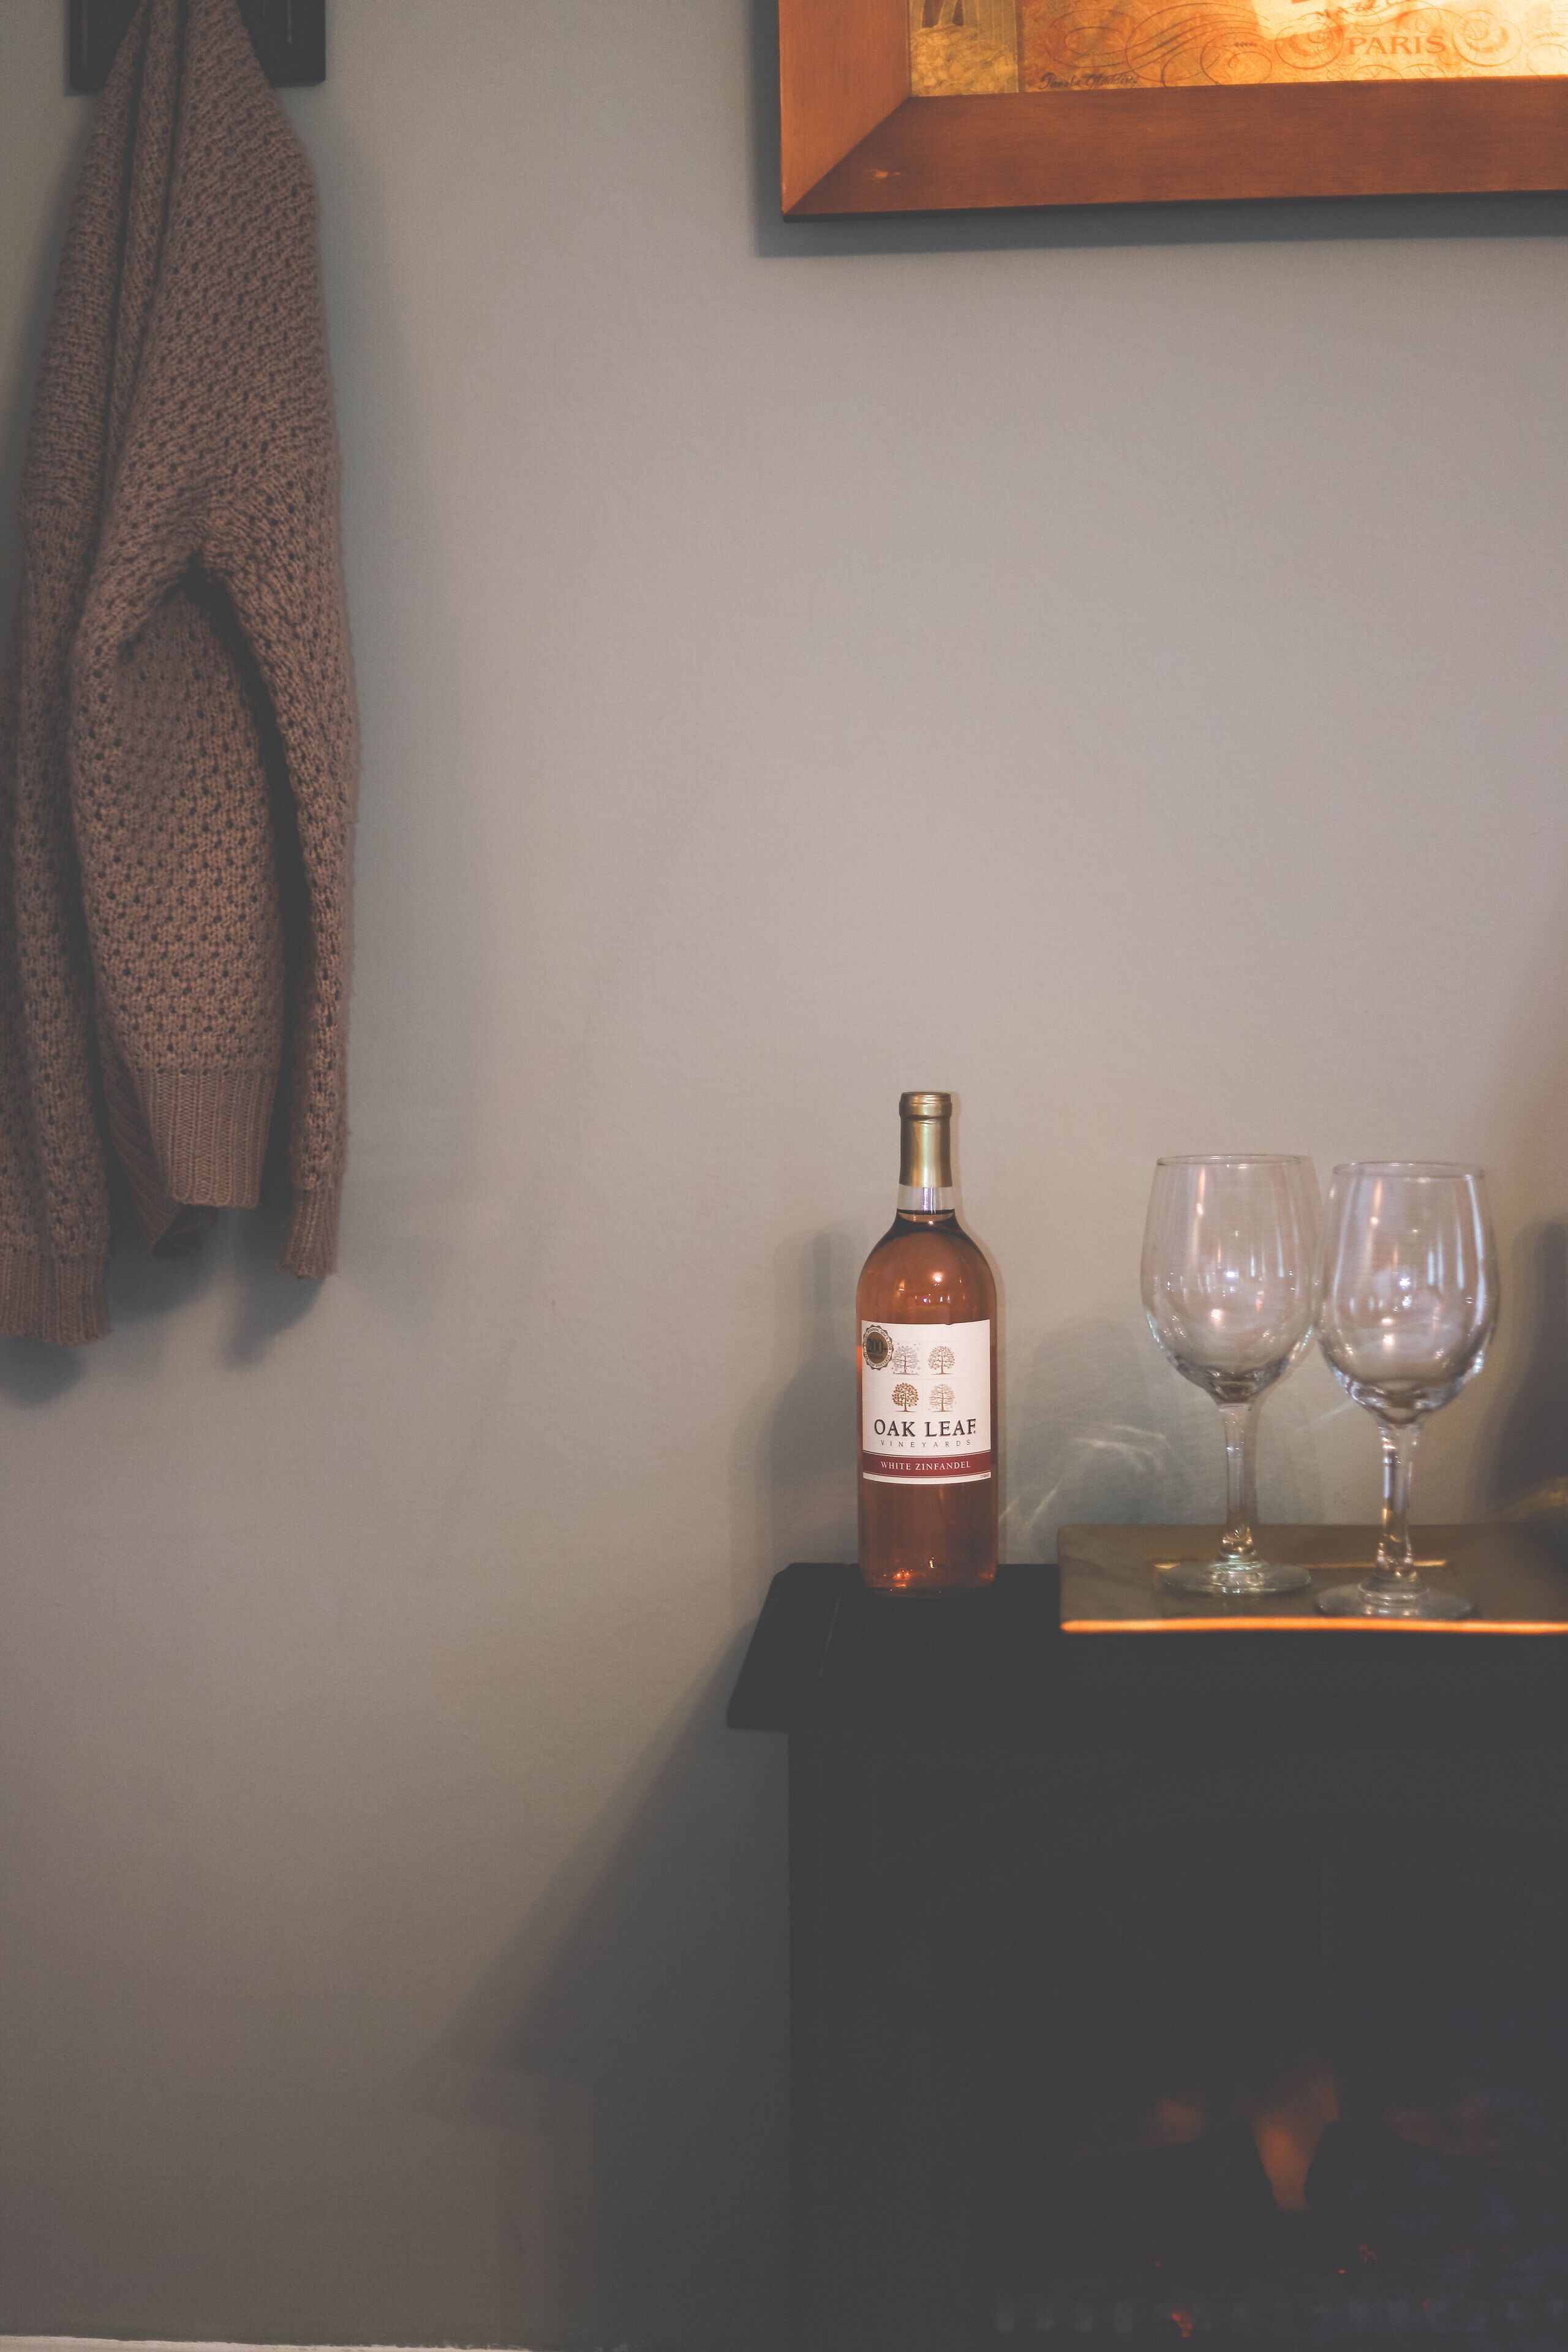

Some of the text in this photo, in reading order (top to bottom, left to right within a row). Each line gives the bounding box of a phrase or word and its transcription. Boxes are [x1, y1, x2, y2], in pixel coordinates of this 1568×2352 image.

[1349, 36, 1447, 55] PARIS
[874, 1418, 976, 1437] OAK LEAF
[881, 1461, 971, 1470] WHITE ZINFANDEL
